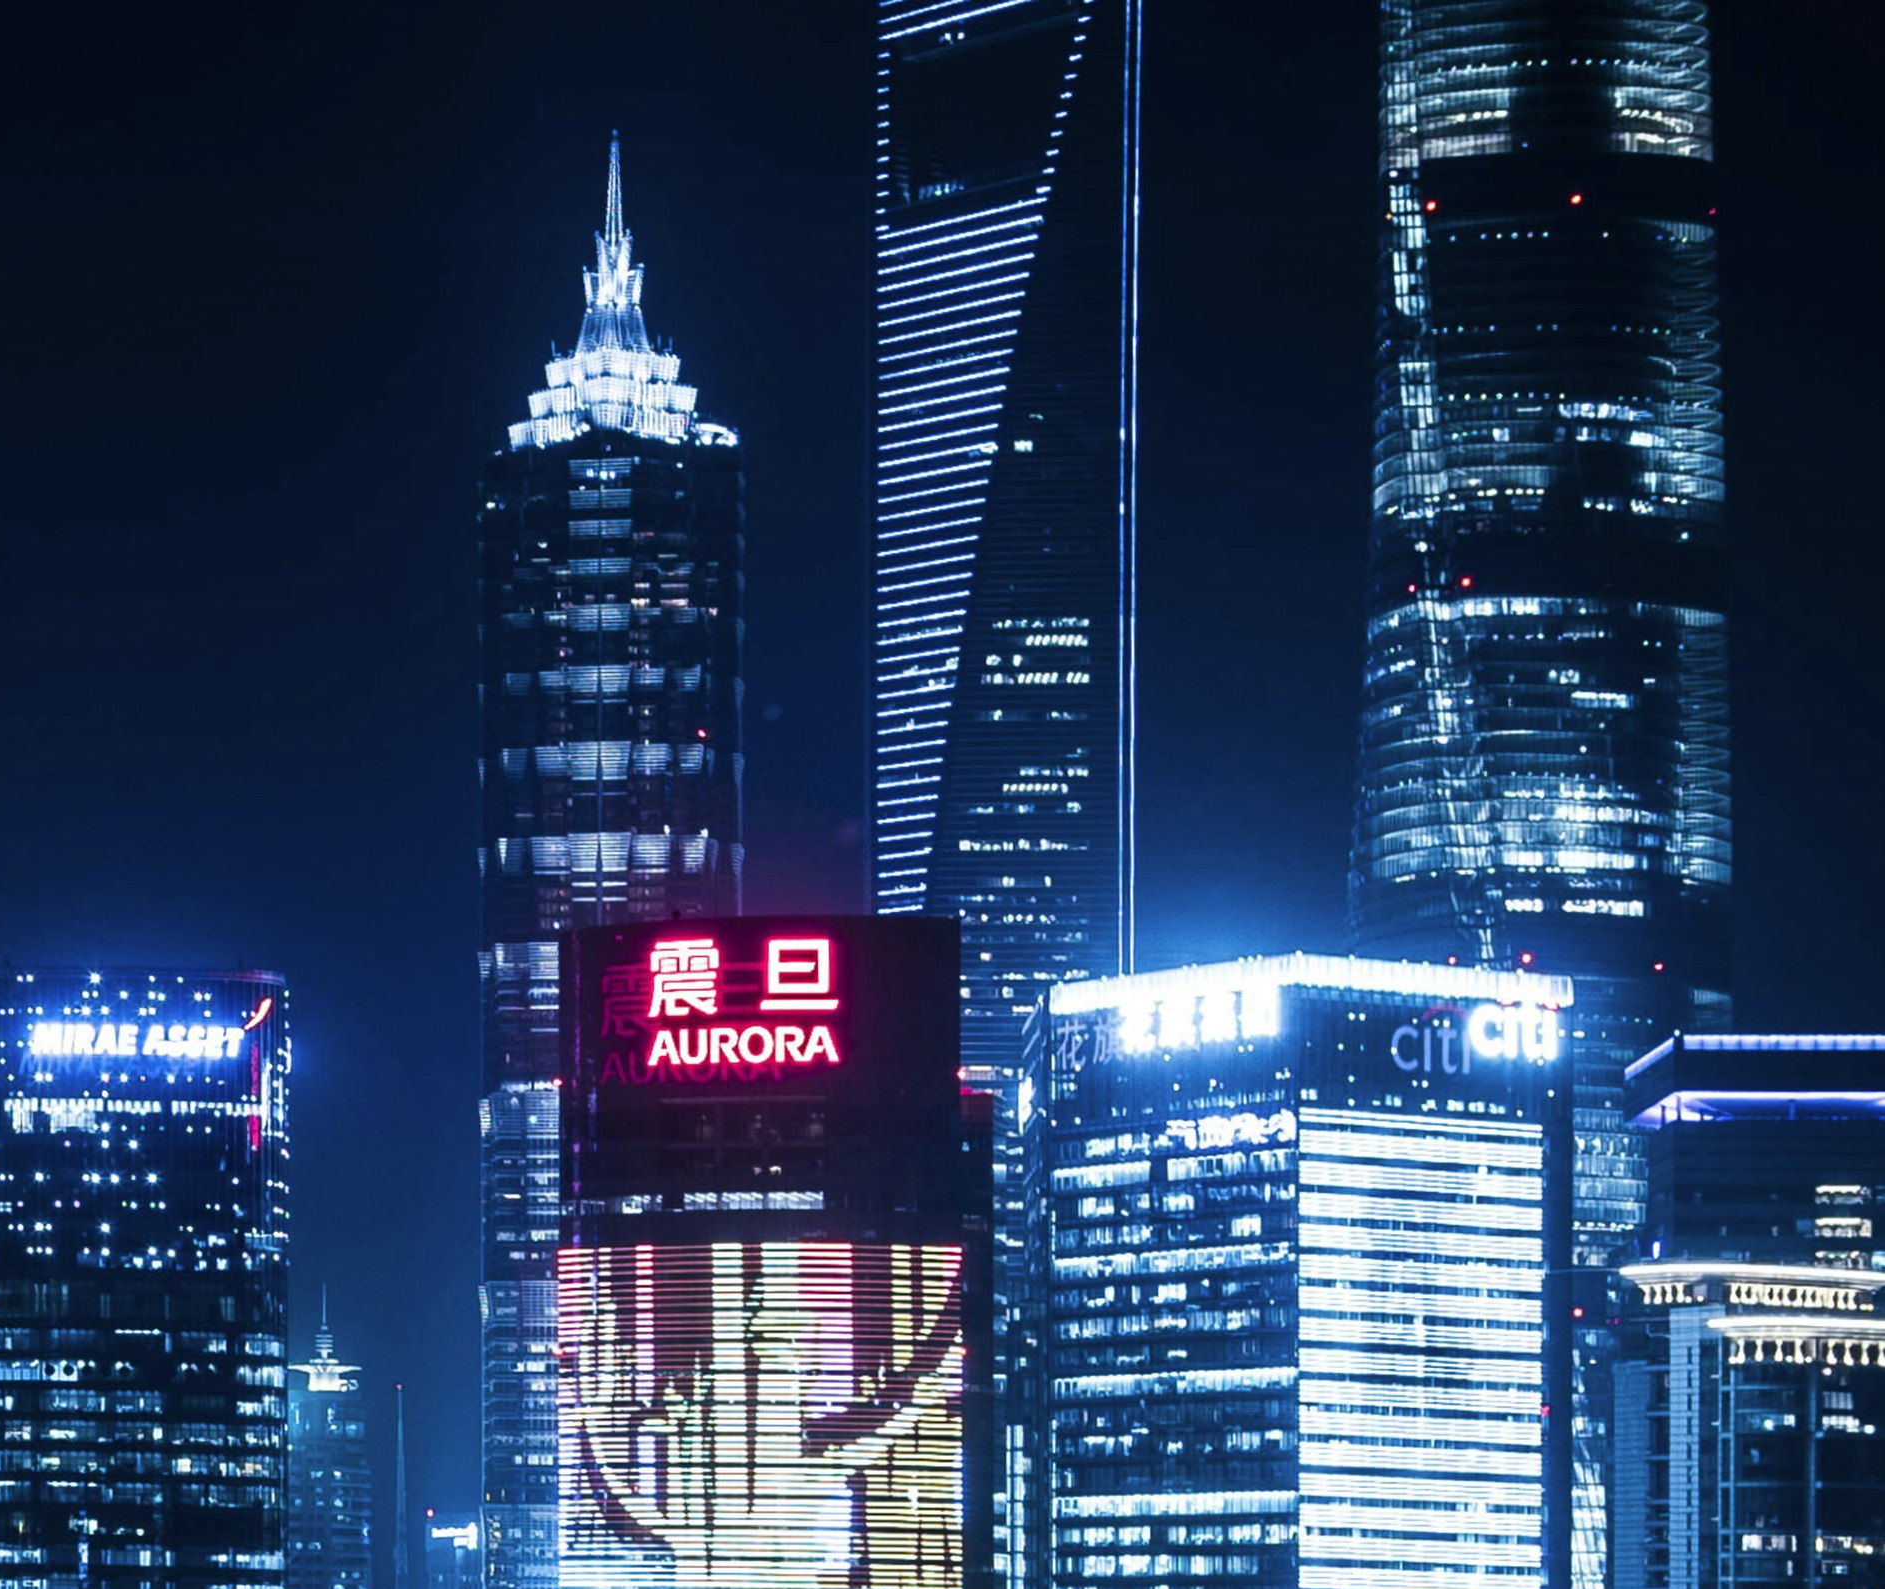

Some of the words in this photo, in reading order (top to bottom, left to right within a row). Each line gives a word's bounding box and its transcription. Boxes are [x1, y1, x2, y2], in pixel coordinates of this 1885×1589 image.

[648, 938, 839, 1018] 震旦
[31, 1022, 137, 1056] MIRAE
[143, 1024, 245, 1059] ASSET
[647, 1025, 841, 1067] AURORA
[1468, 1003, 1559, 1061] citi
